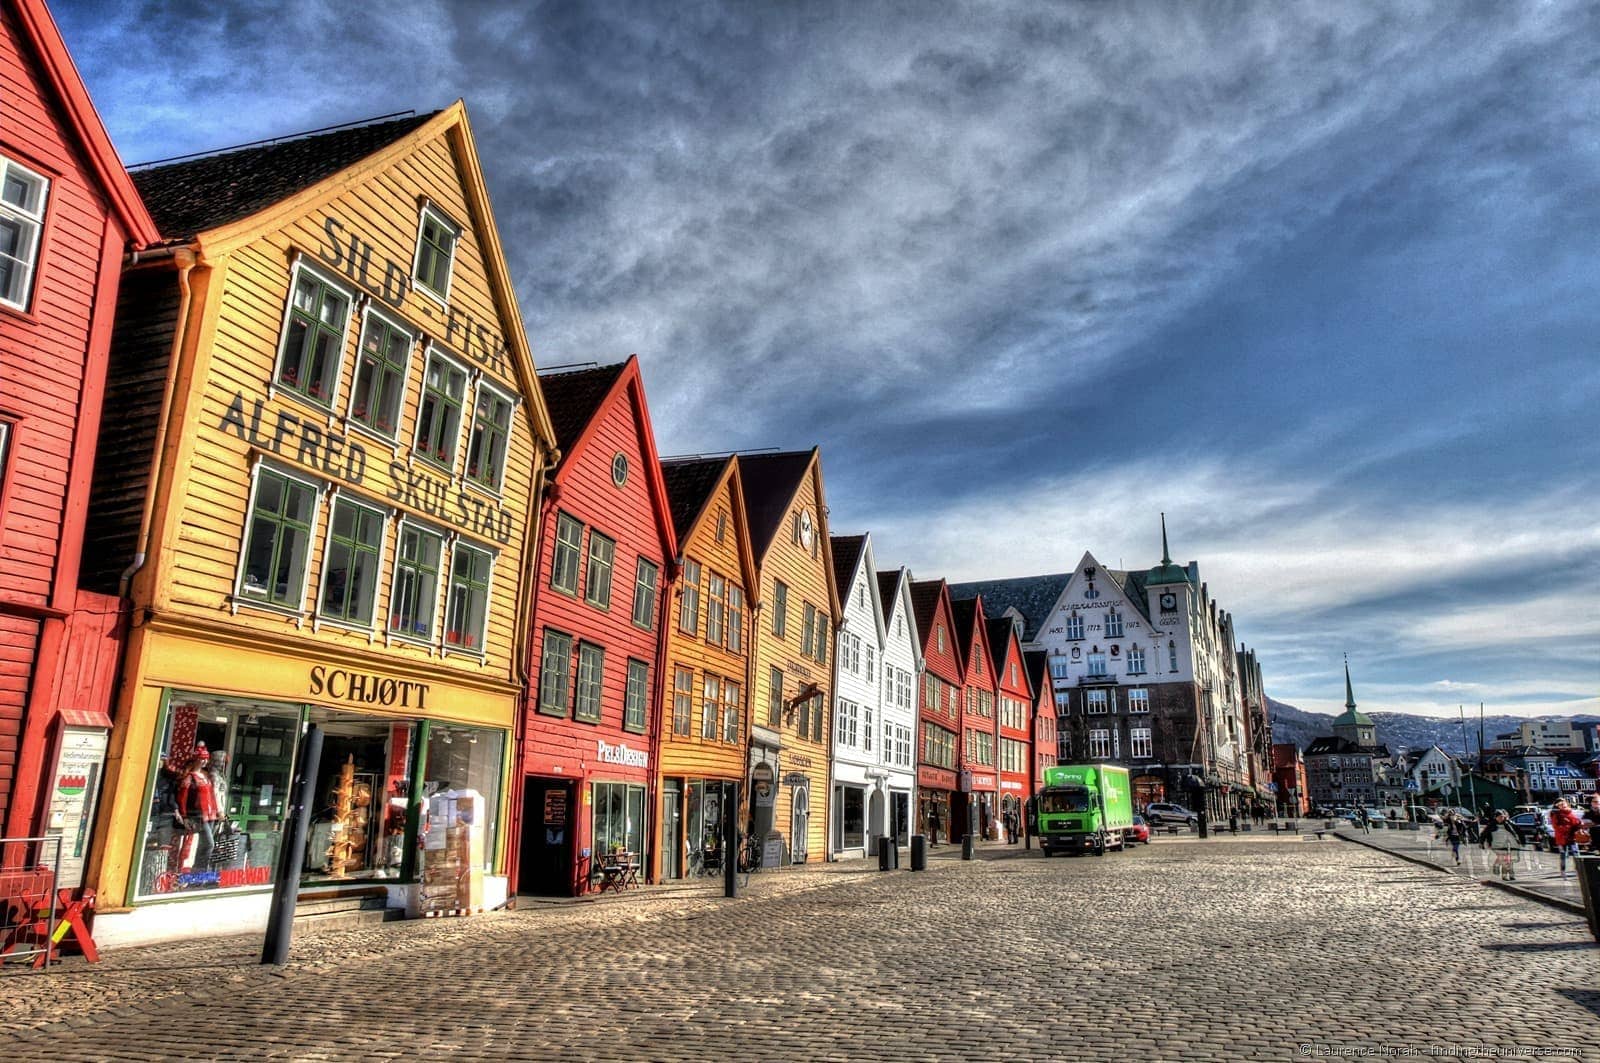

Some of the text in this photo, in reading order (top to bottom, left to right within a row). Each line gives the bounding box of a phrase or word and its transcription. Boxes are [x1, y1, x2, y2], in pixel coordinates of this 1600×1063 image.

[319, 216, 408, 309] SILD
[444, 304, 509, 376] FISK
[218, 390, 513, 545] ALFRED SKULSTAD
[309, 665, 430, 709] SCHJØTT
